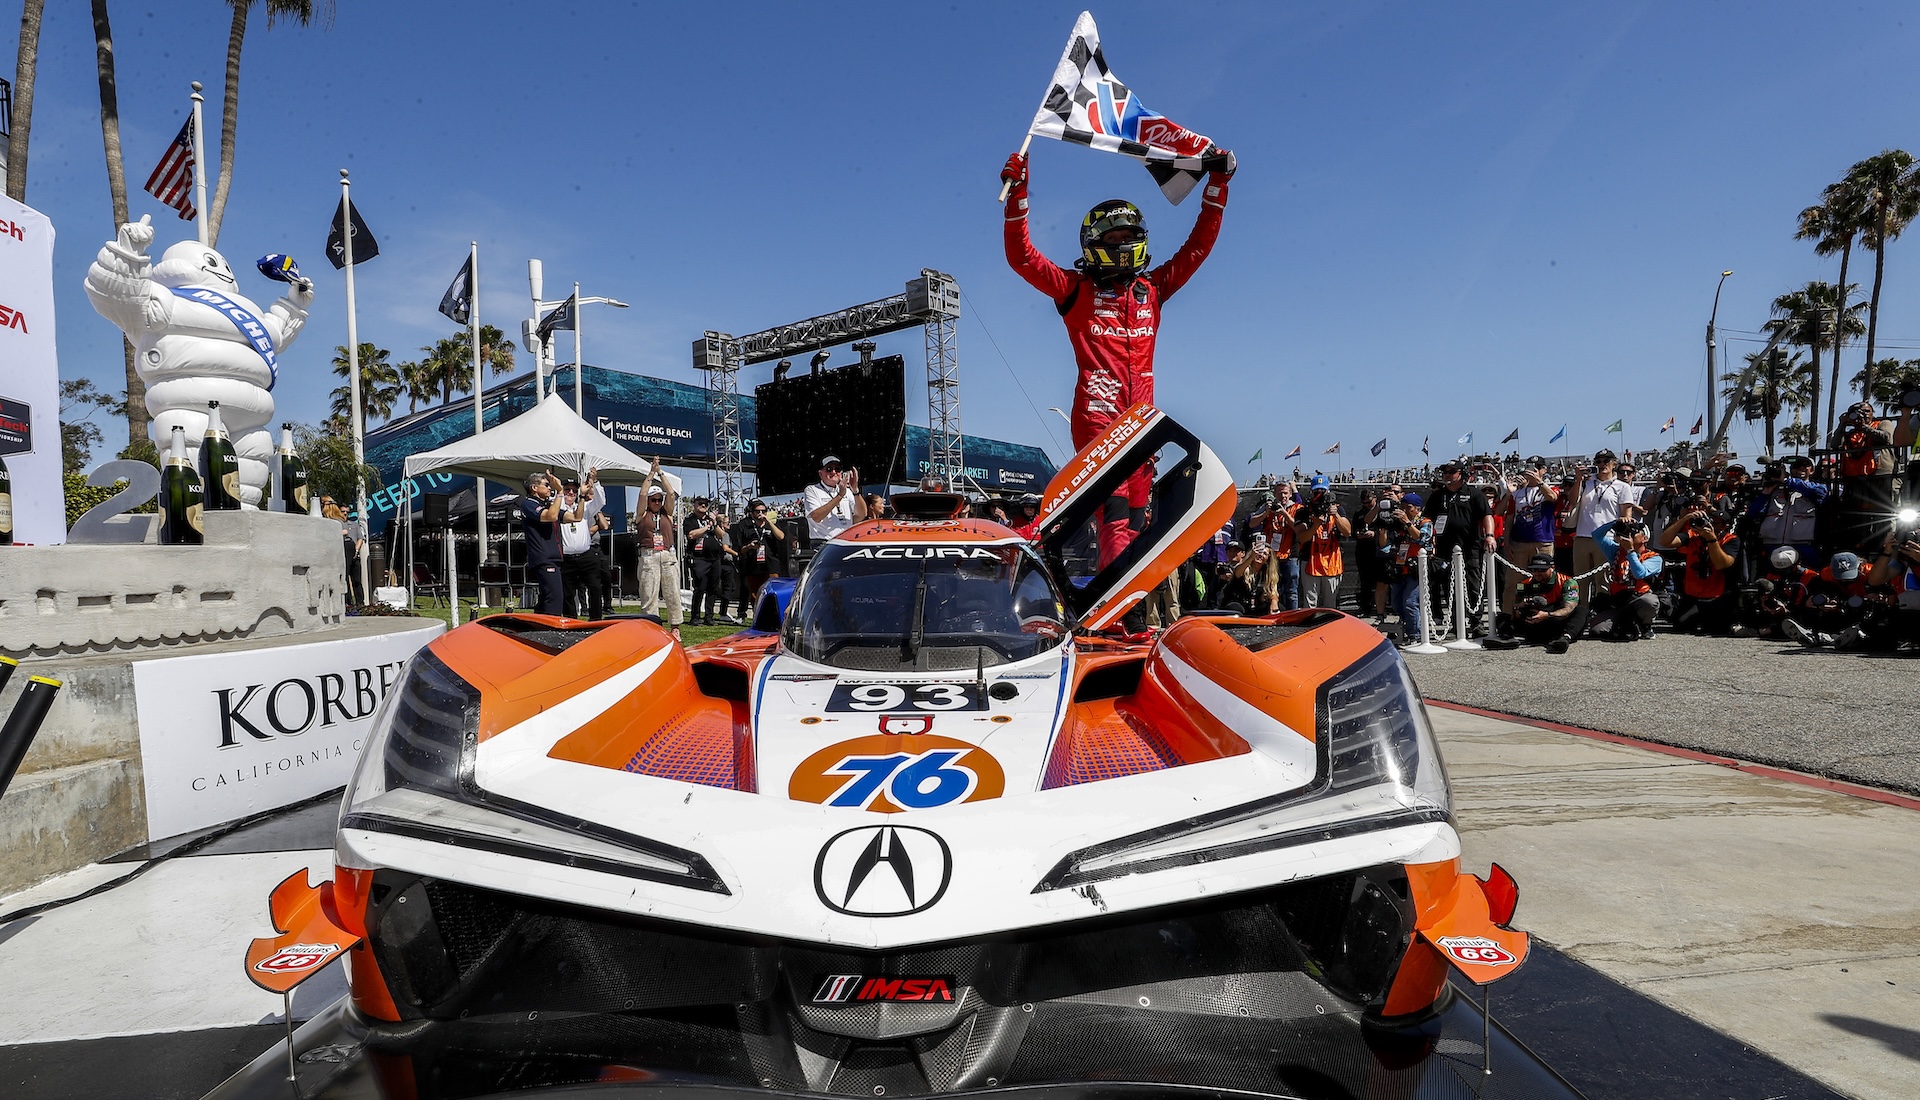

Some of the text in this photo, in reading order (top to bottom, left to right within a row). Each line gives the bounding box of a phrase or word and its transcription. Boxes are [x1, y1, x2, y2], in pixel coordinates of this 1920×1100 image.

[1145, 119, 1204, 149] Racing
[192, 290, 279, 378] MICHELI
[1103, 326, 1154, 338] ACURA
[615, 421, 692, 439] Port of LONG BEACH
[615, 432, 671, 445] THE PORT OF CHOICE
[1082, 415, 1134, 464] YELLOLY
[919, 460, 945, 475] SPED
[1043, 419, 1142, 514] VAN DER ZANDE
[66, 459, 161, 544] 2
[348, 477, 420, 521] PEED
[842, 547, 1002, 561] ACURA
[211, 660, 405, 751] KORBE
[848, 684, 969, 711] 93
[191, 744, 342, 792] CALIFORNIA
[822, 748, 978, 810] 76
[1461, 948, 1499, 960] 66
[856, 978, 954, 1001] IMSA
